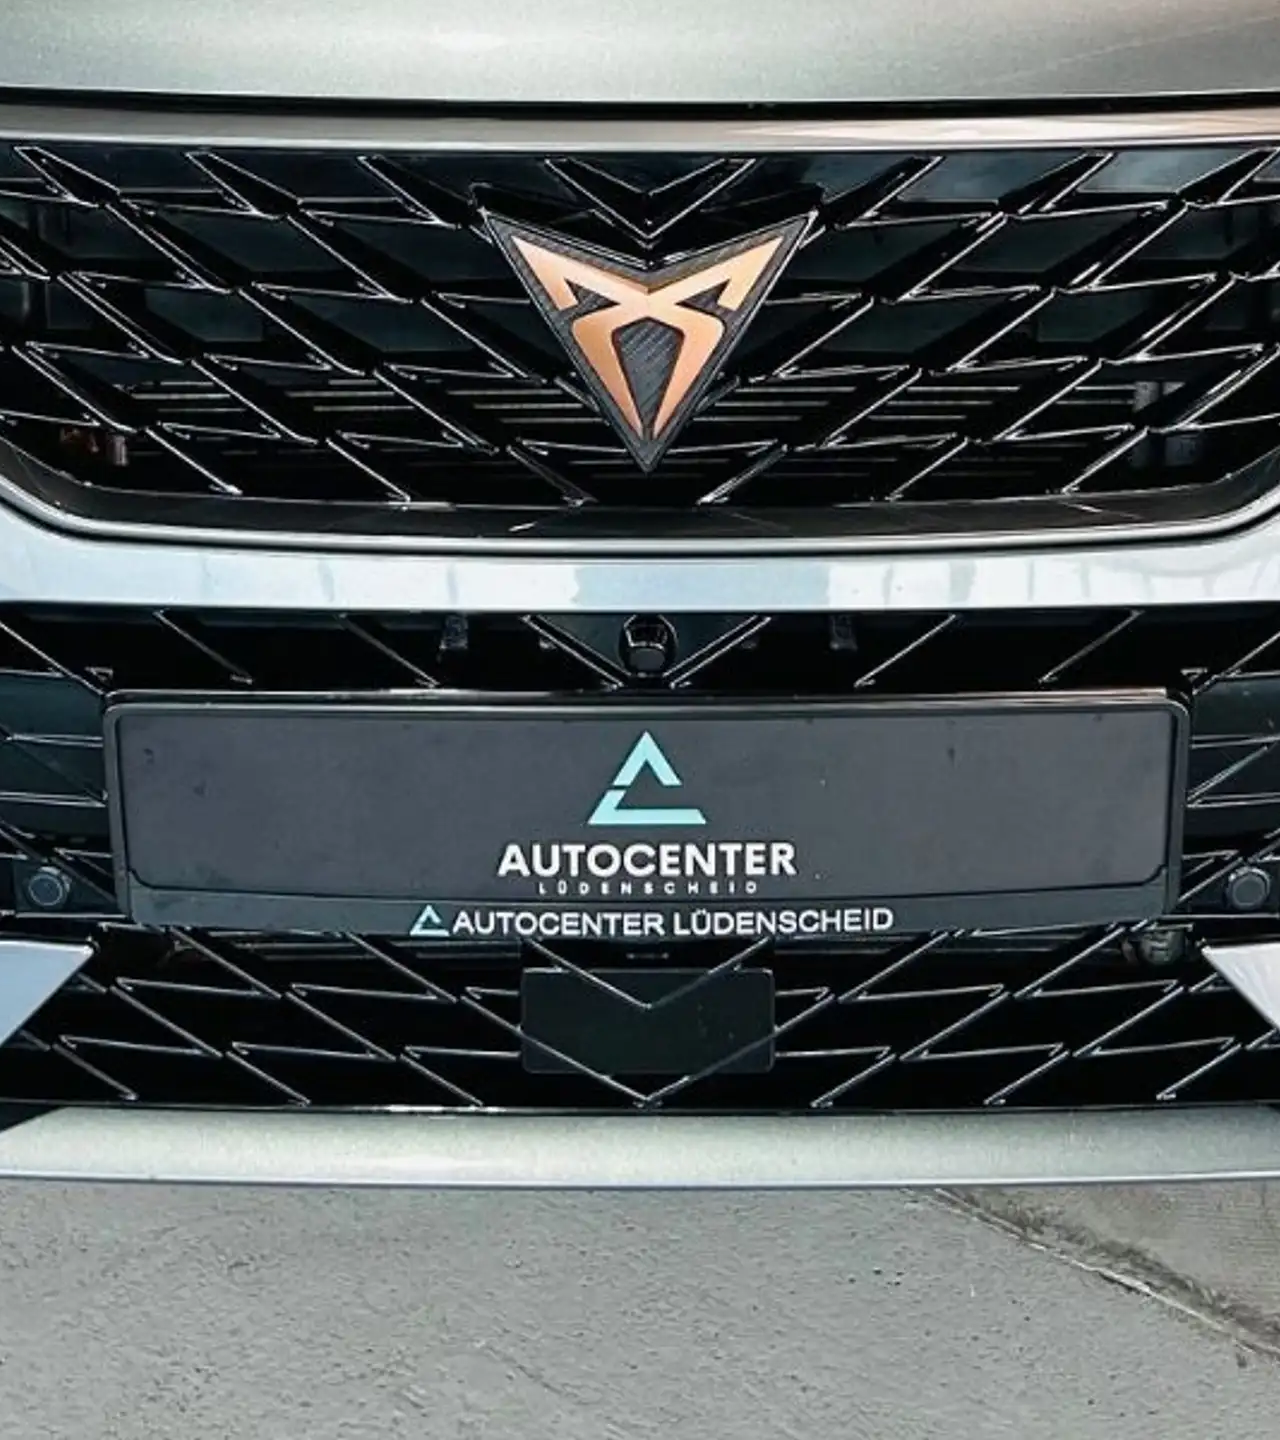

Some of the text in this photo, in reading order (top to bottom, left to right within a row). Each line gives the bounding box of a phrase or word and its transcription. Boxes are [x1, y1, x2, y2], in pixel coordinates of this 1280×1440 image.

[496, 842, 798, 877] AUTOCENTER
[538, 880, 758, 896] LÜDENSCHEID
[452, 908, 895, 937] AUTOCENTER LÜDENSCHEID
